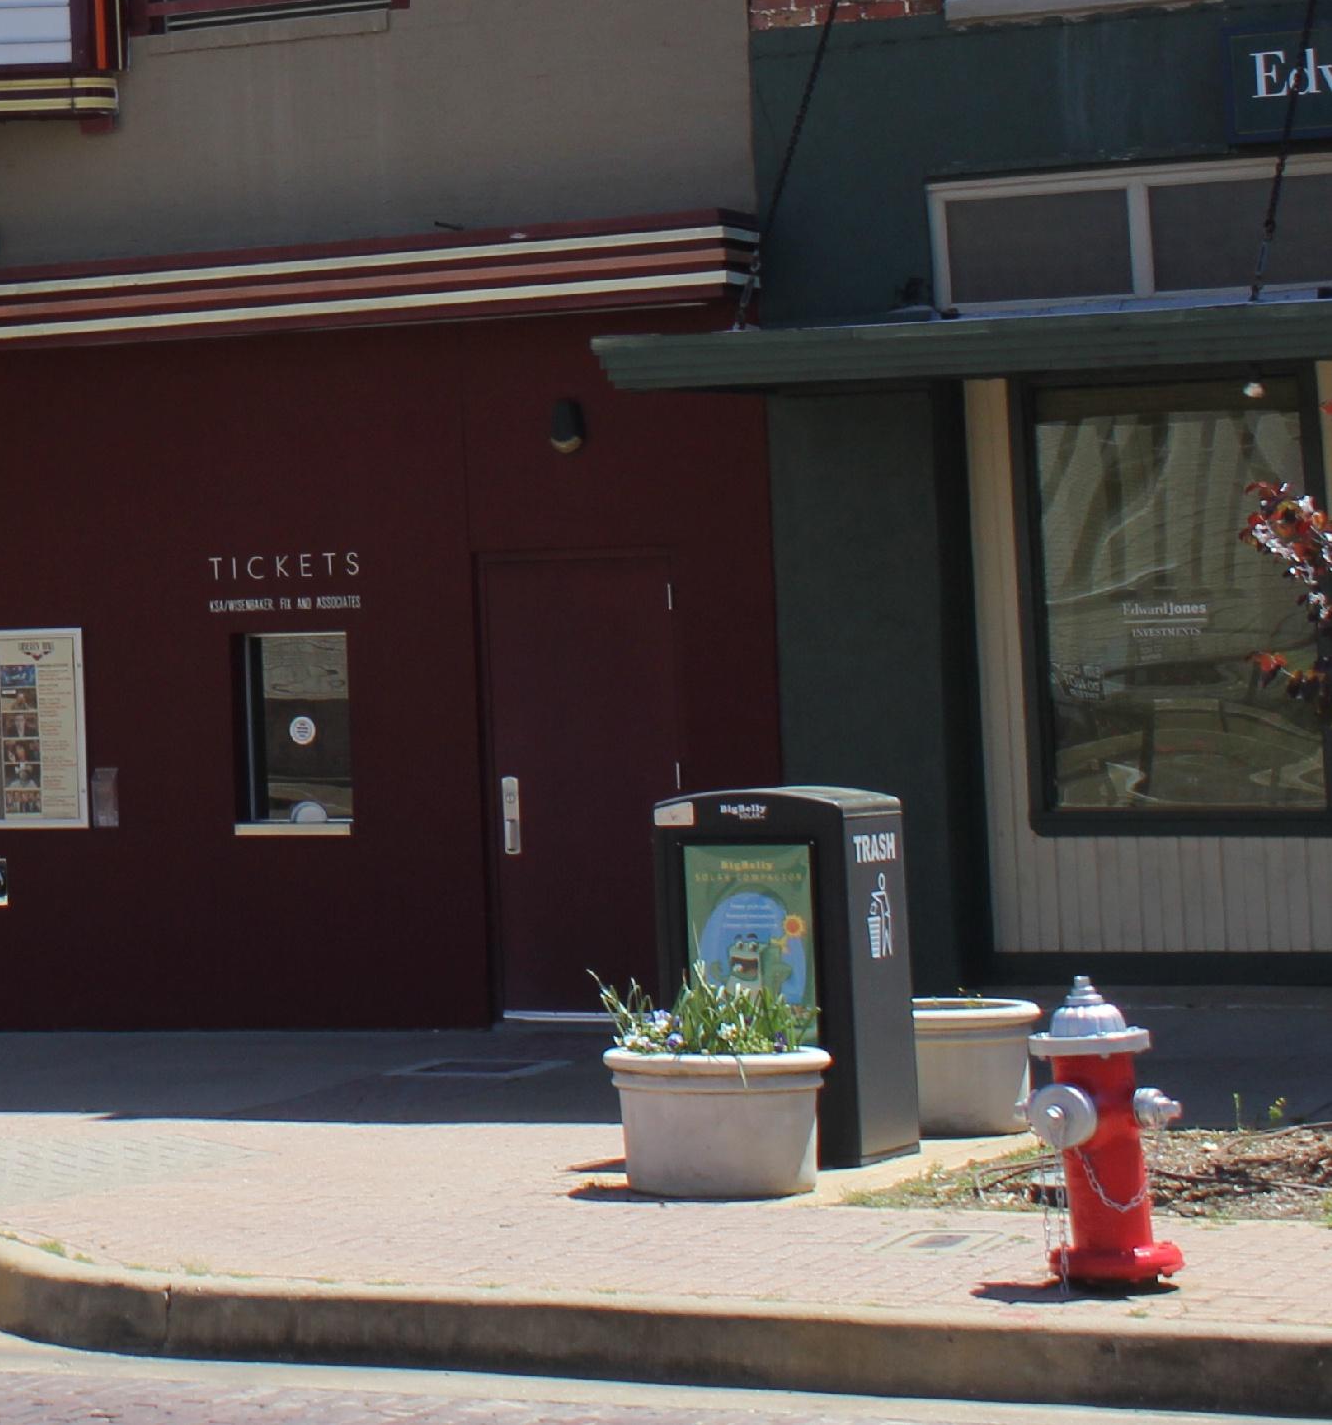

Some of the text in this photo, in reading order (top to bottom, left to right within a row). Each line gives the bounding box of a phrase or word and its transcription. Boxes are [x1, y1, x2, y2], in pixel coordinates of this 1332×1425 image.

[208, 551, 361, 581] TICKETS
[297, 596, 312, 610] AND
[316, 595, 362, 609] ASSOCIATES
[1132, 627, 1202, 639] INVESTMENTS
[719, 803, 767, 817] BigBelly
[852, 832, 896, 864] TRASH
